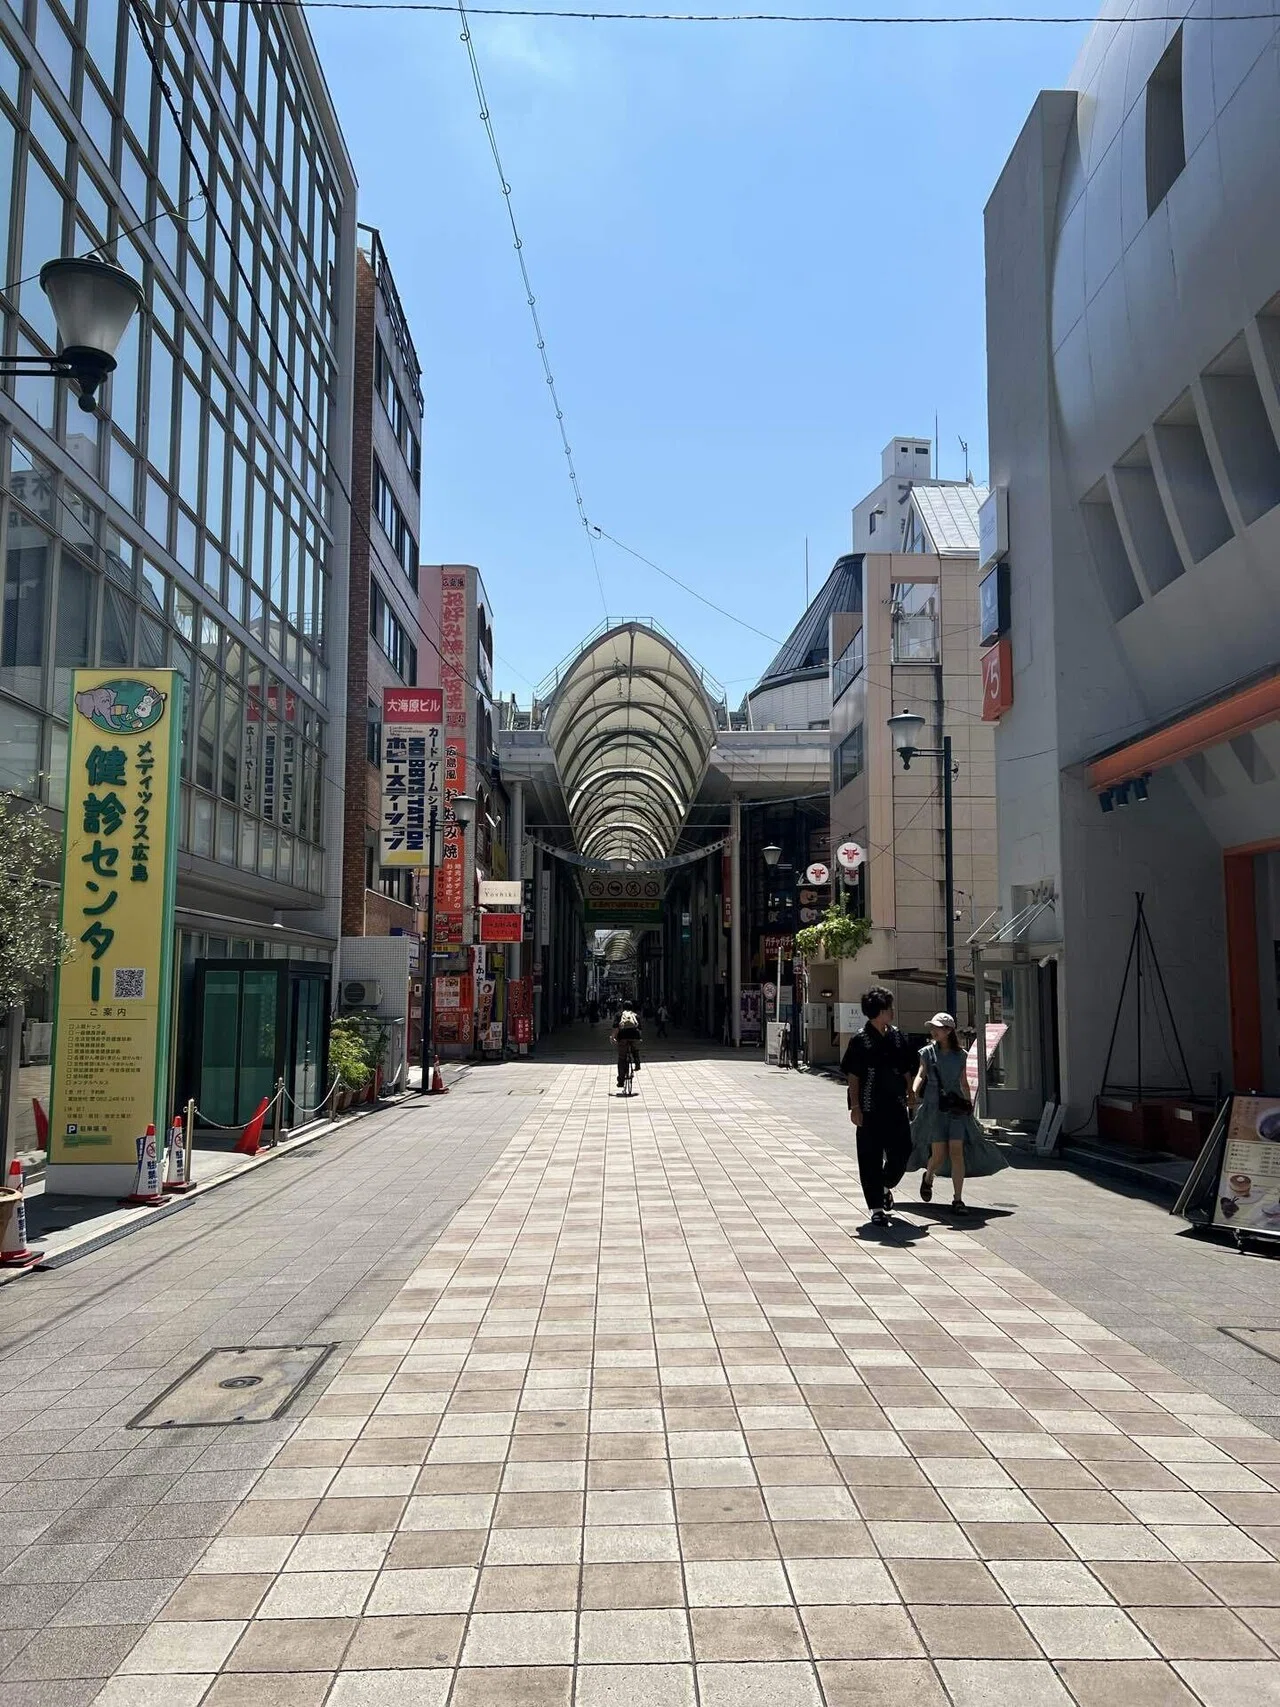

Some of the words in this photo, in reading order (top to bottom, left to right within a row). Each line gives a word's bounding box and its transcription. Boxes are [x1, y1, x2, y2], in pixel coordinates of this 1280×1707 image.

[386, 698, 441, 713] 大海原ビル
[428, 727, 439, 757] カード
[428, 761, 439, 792] ゲーム
[129, 740, 154, 883] メディックス広島
[384, 737, 408, 850] ホビーステーション
[406, 738, 426, 850] HOBBYSTATION
[79, 744, 129, 1003] 健診センター
[68, 1125, 76, 1133] P
